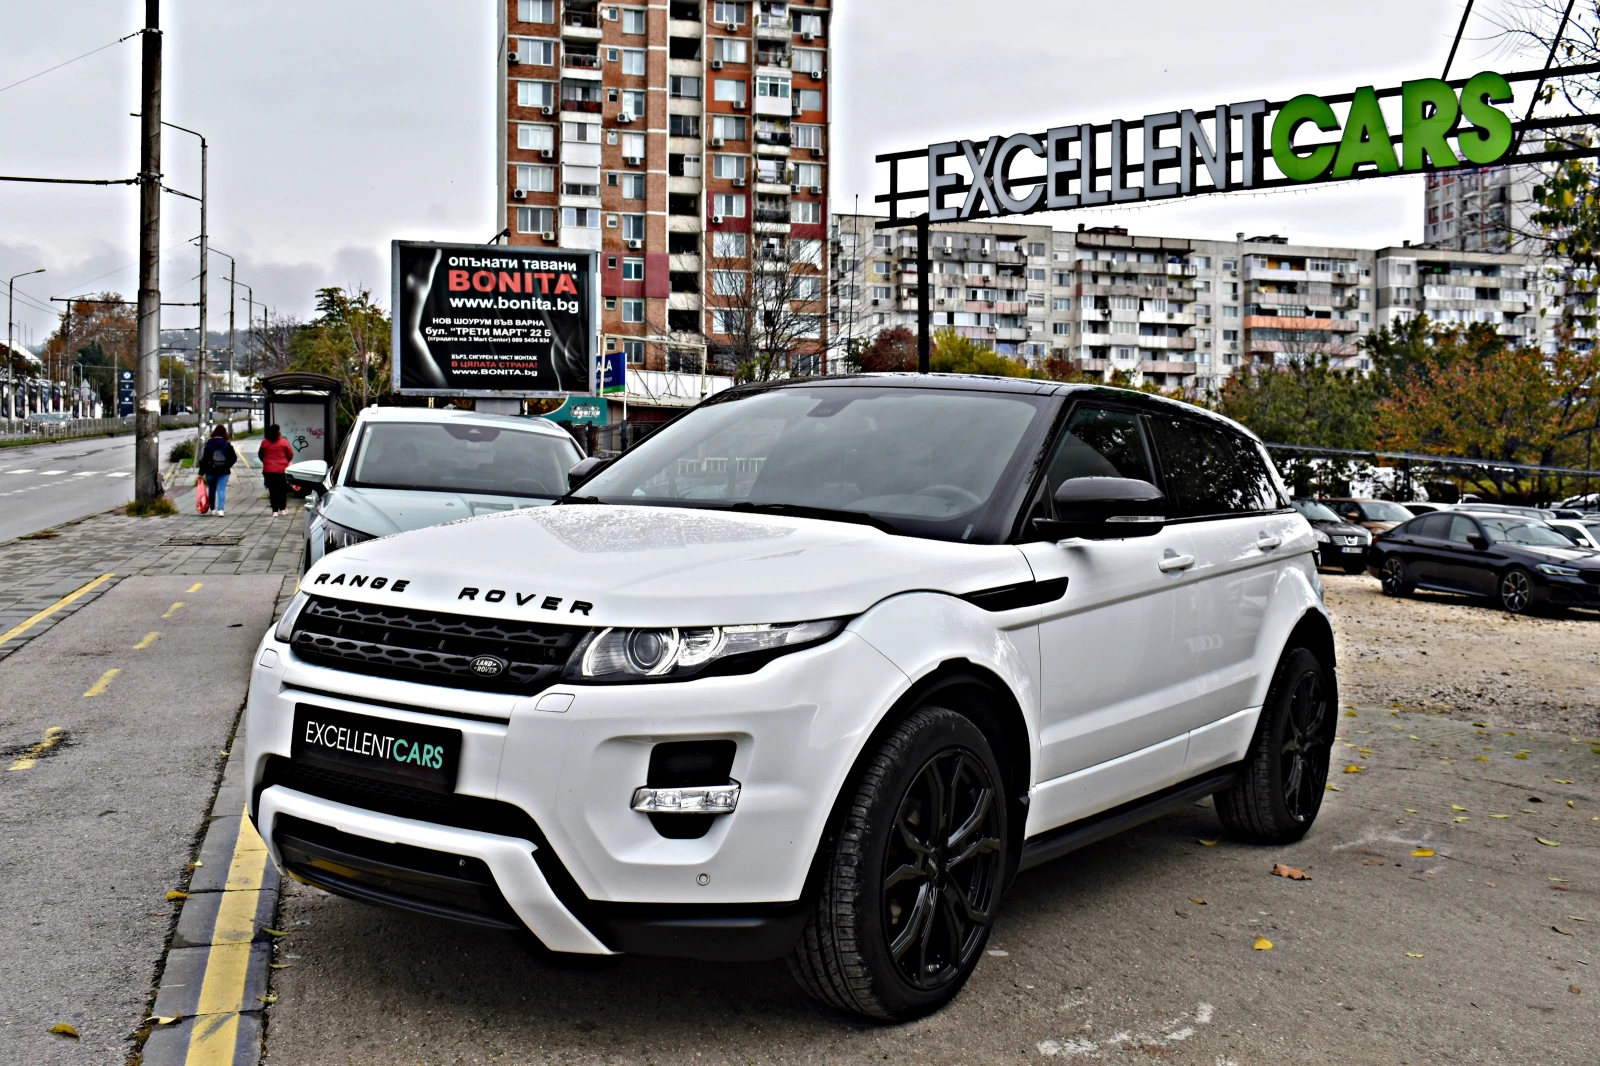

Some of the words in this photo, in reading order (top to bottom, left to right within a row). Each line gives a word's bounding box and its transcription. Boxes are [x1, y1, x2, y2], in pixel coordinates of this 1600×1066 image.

[448, 256, 518, 269] опънати
[522, 259, 577, 271] тавани
[448, 269, 578, 295] BONITA
[449, 296, 579, 313] www.bonita.bg
[432, 317, 452, 325] НОВ
[453, 318, 492, 326] ШОУРУМ
[515, 319, 545, 327] ВАРНА
[425, 327, 448, 335] бул.
[529, 329, 542, 337] 22
[544, 329, 551, 337] Б
[451, 368, 538, 377] www.BONITA.bg
[313, 572, 411, 593] RANGE
[457, 586, 595, 616] ROVER
[476, 665, 498, 674] ROVER
